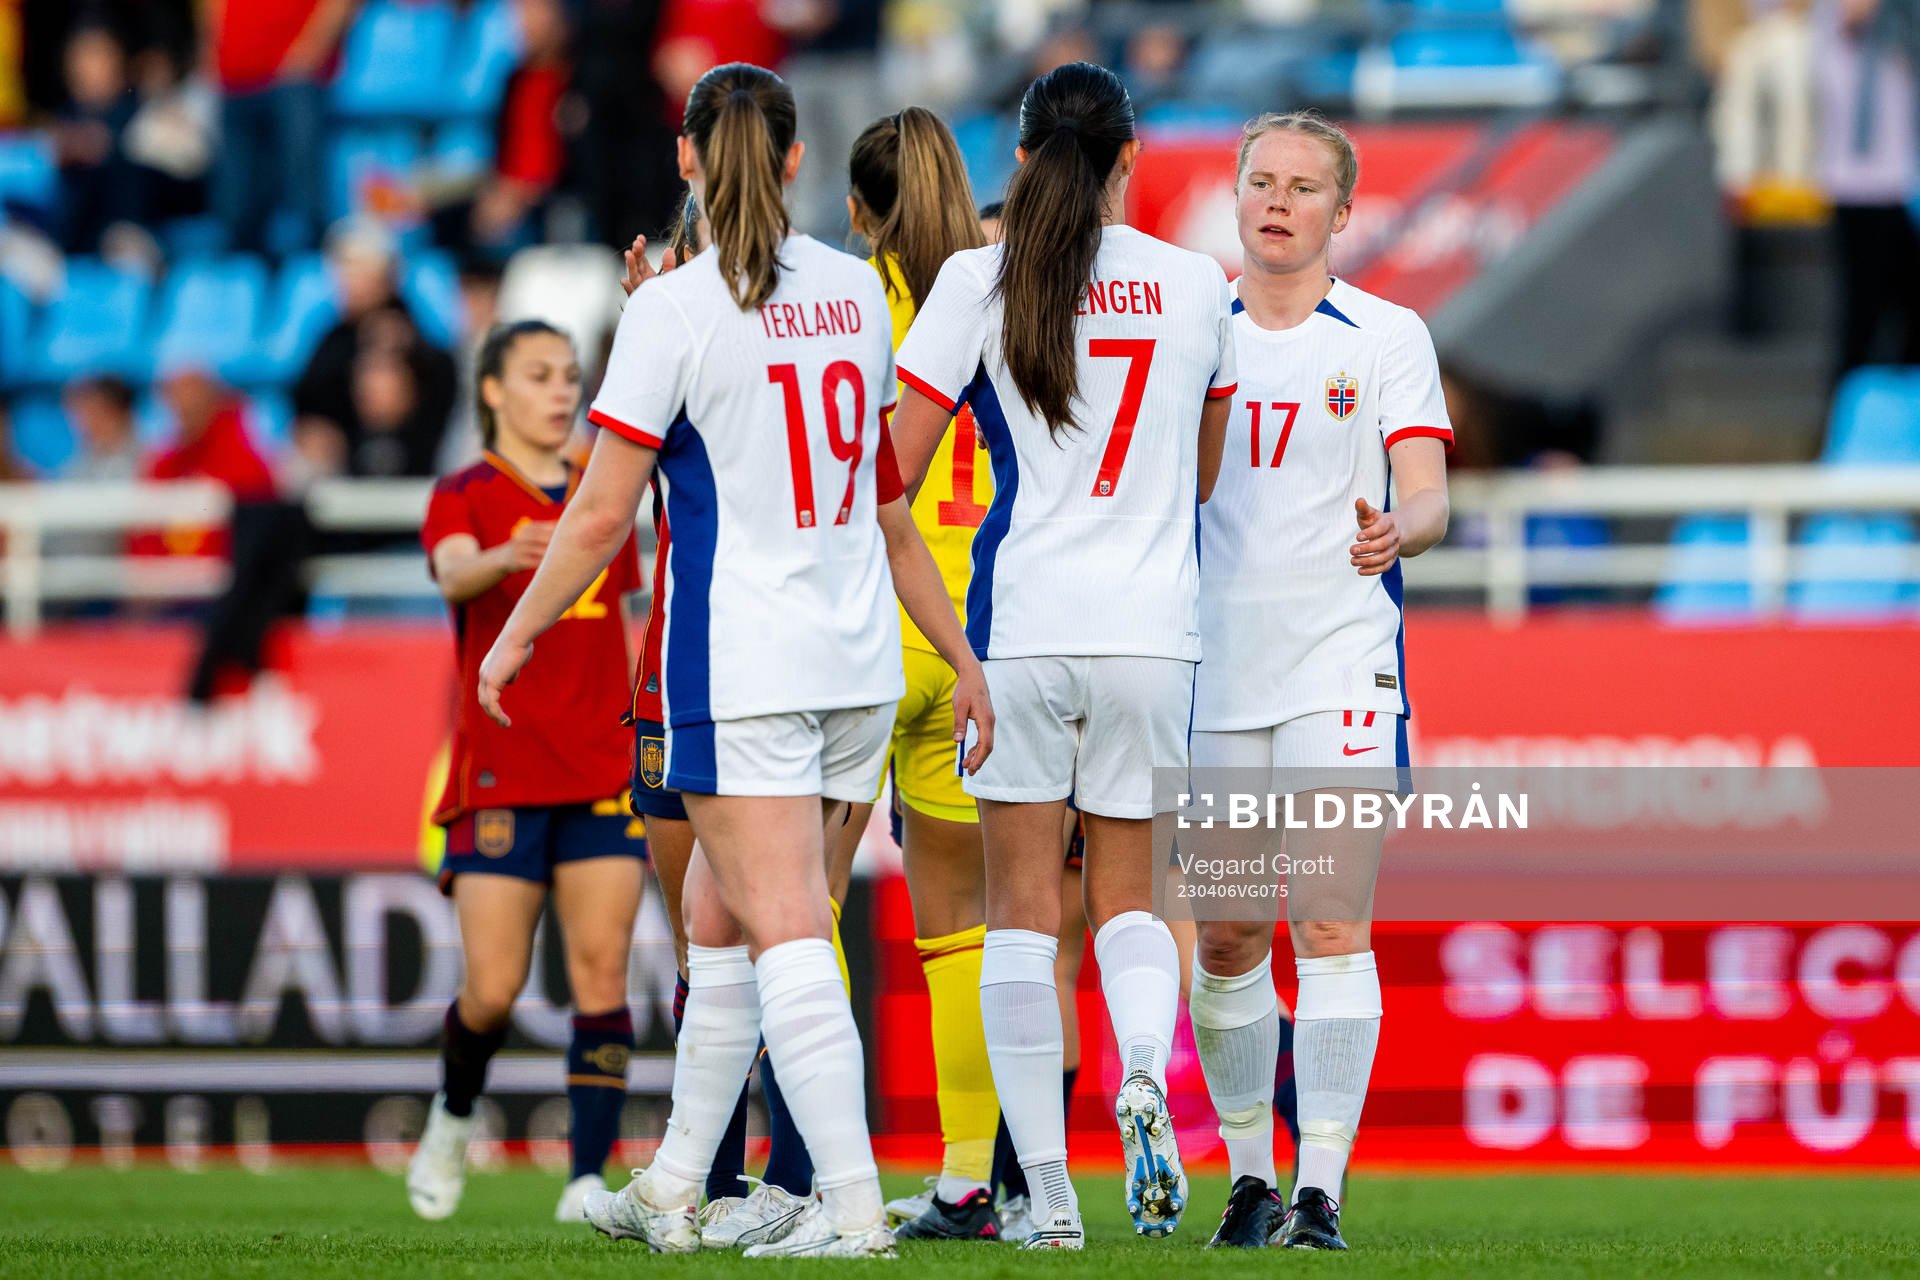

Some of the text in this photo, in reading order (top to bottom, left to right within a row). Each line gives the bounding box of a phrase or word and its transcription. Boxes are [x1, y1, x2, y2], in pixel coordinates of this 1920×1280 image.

[755, 299, 862, 338] TERLAND
[767, 360, 866, 528] 19
[1088, 338, 1157, 498] 7
[1245, 401, 1301, 468] 17
[559, 566, 608, 619] 2
[0, 672, 318, 783] etwork
[1440, 921, 1920, 1022] SELEC
[1463, 1053, 1650, 1150] DE
[1053, 1219, 1071, 1227] KING
